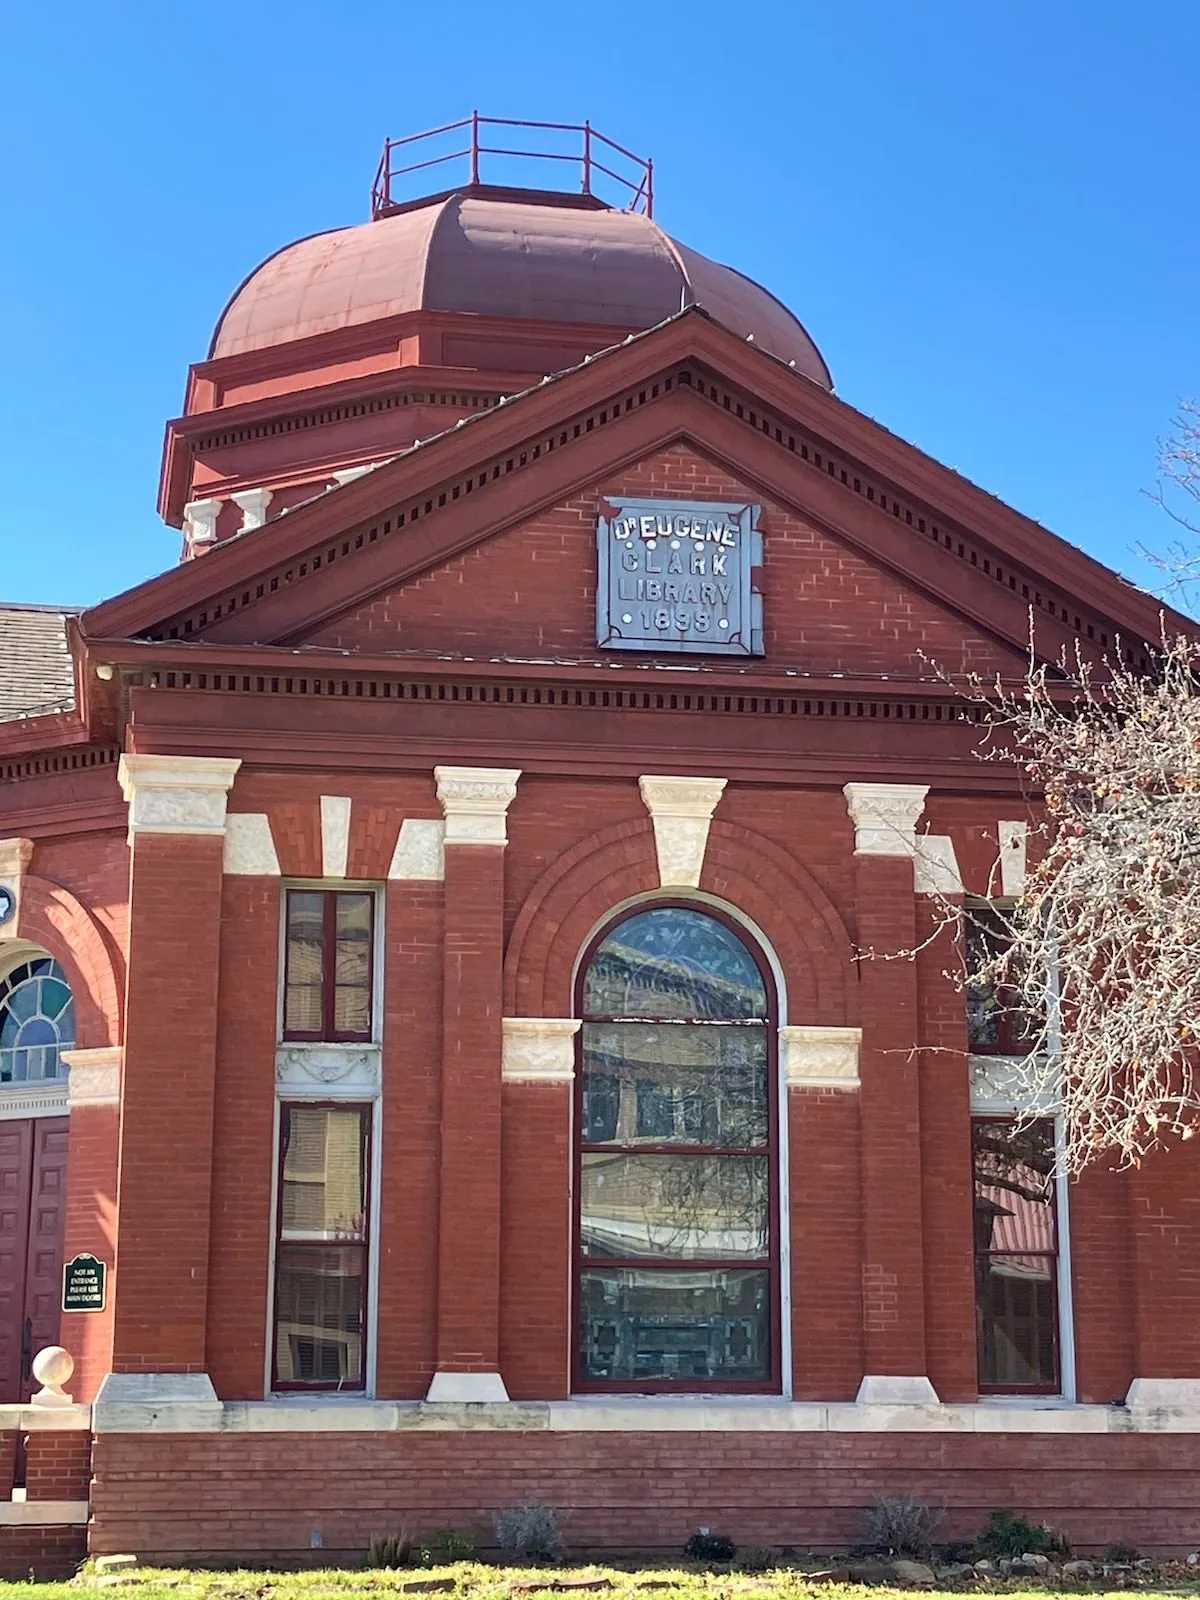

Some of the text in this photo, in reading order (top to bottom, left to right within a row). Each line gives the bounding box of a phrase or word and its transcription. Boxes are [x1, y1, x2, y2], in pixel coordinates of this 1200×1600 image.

[640, 515, 739, 547] EUGENE
[622, 551, 727, 576] CLARK
[618, 578, 733, 605] LIBRARY
[71, 1277, 98, 1285] ENTRANCE
[88, 1285, 98, 1293] USE
